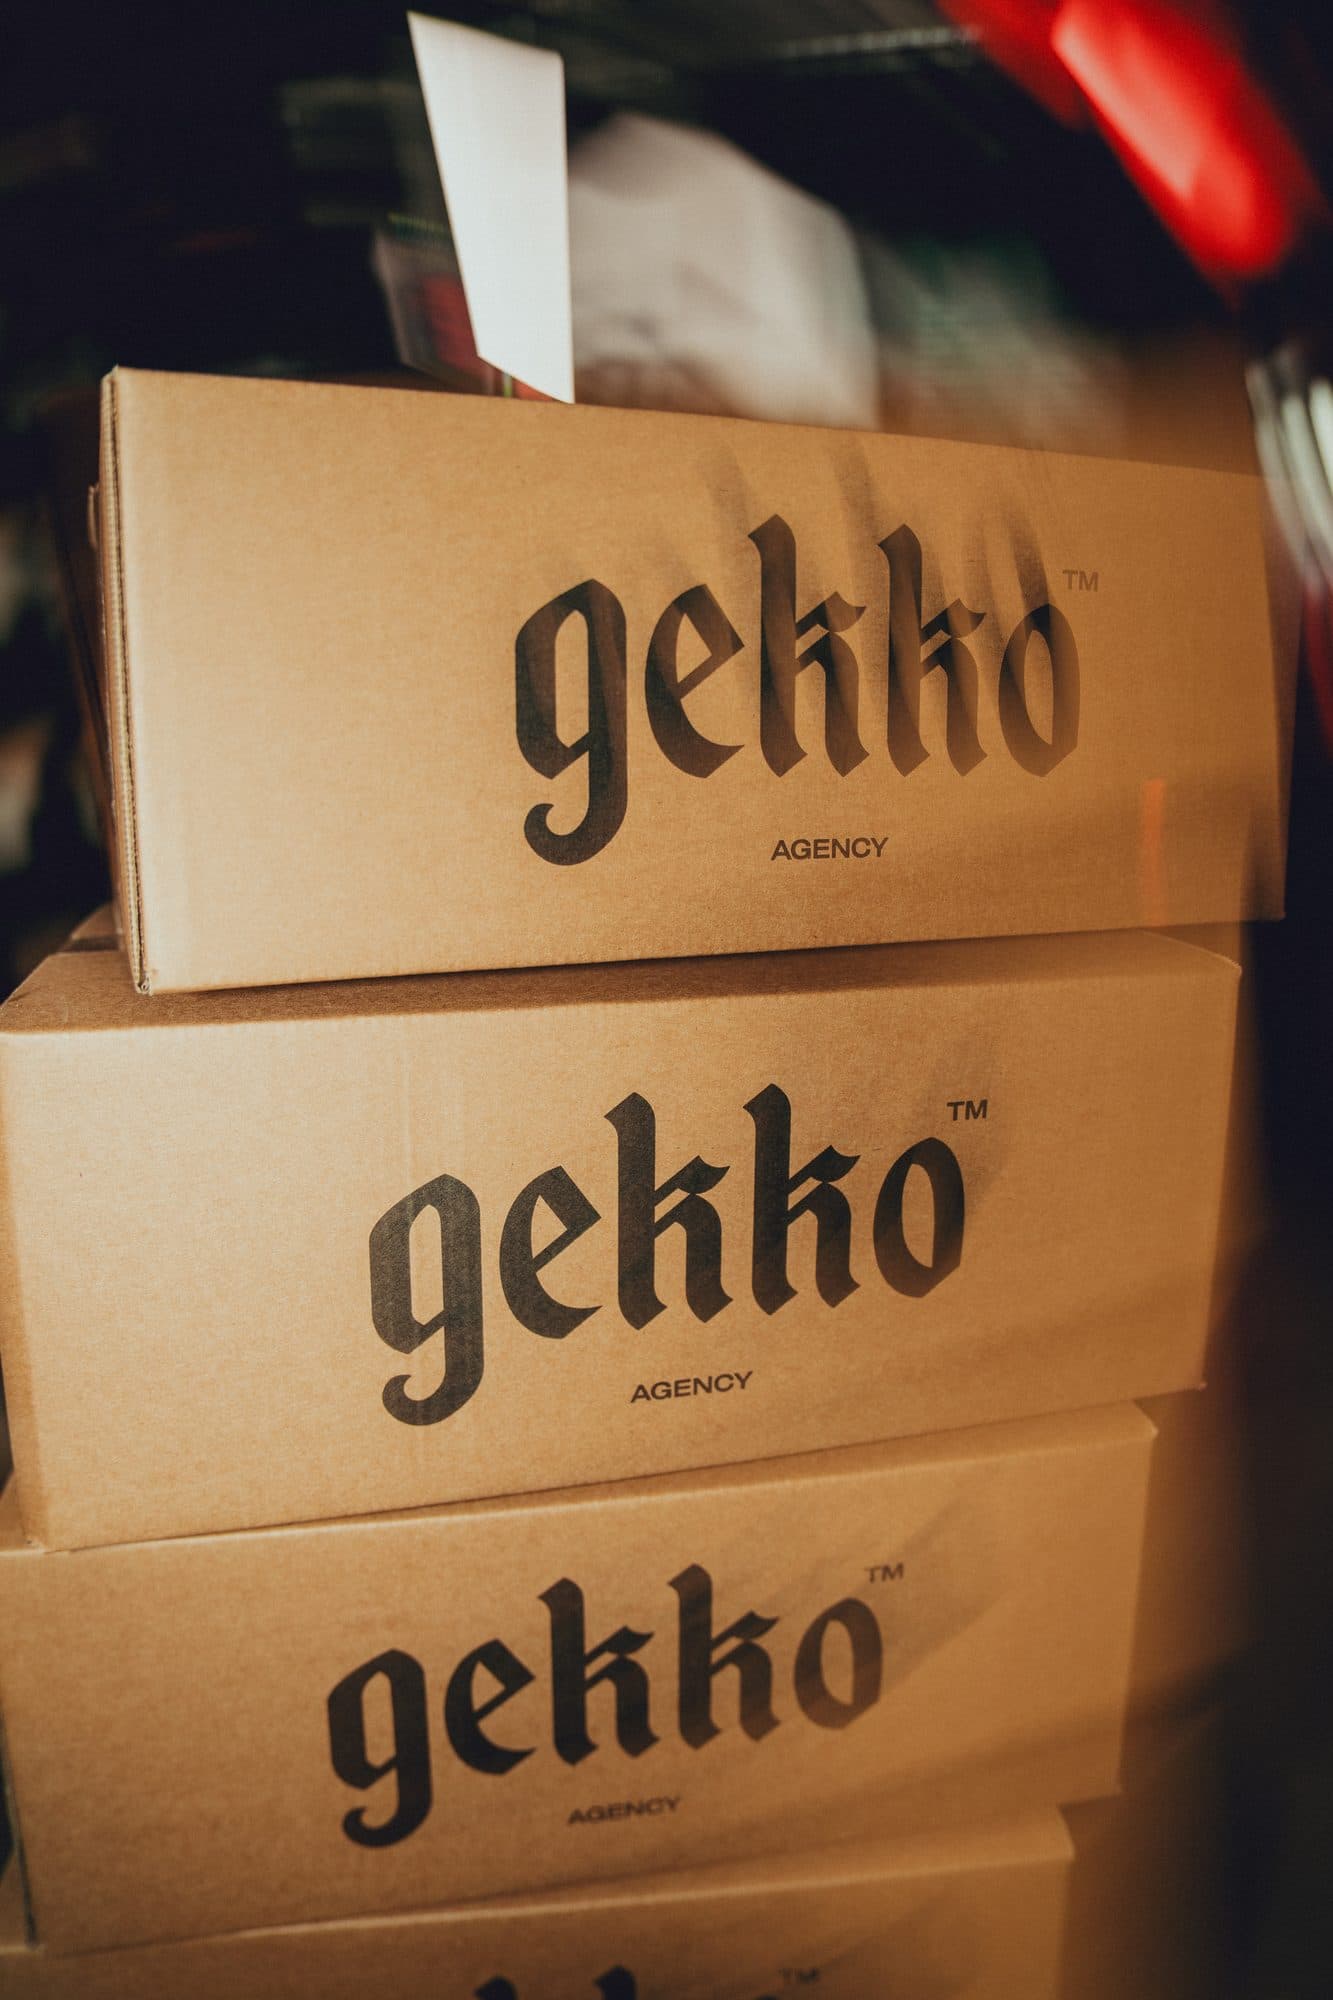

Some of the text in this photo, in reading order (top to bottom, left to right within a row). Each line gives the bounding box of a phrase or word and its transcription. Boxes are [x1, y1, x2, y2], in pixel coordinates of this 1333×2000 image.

[515, 514, 1080, 866] gekko
[770, 836, 889, 862] AGENCY
[369, 1083, 965, 1426] gekko
[630, 1371, 754, 1404] AGENCY
[327, 1563, 883, 1848] gekko
[567, 1796, 681, 1825] AGENCY
